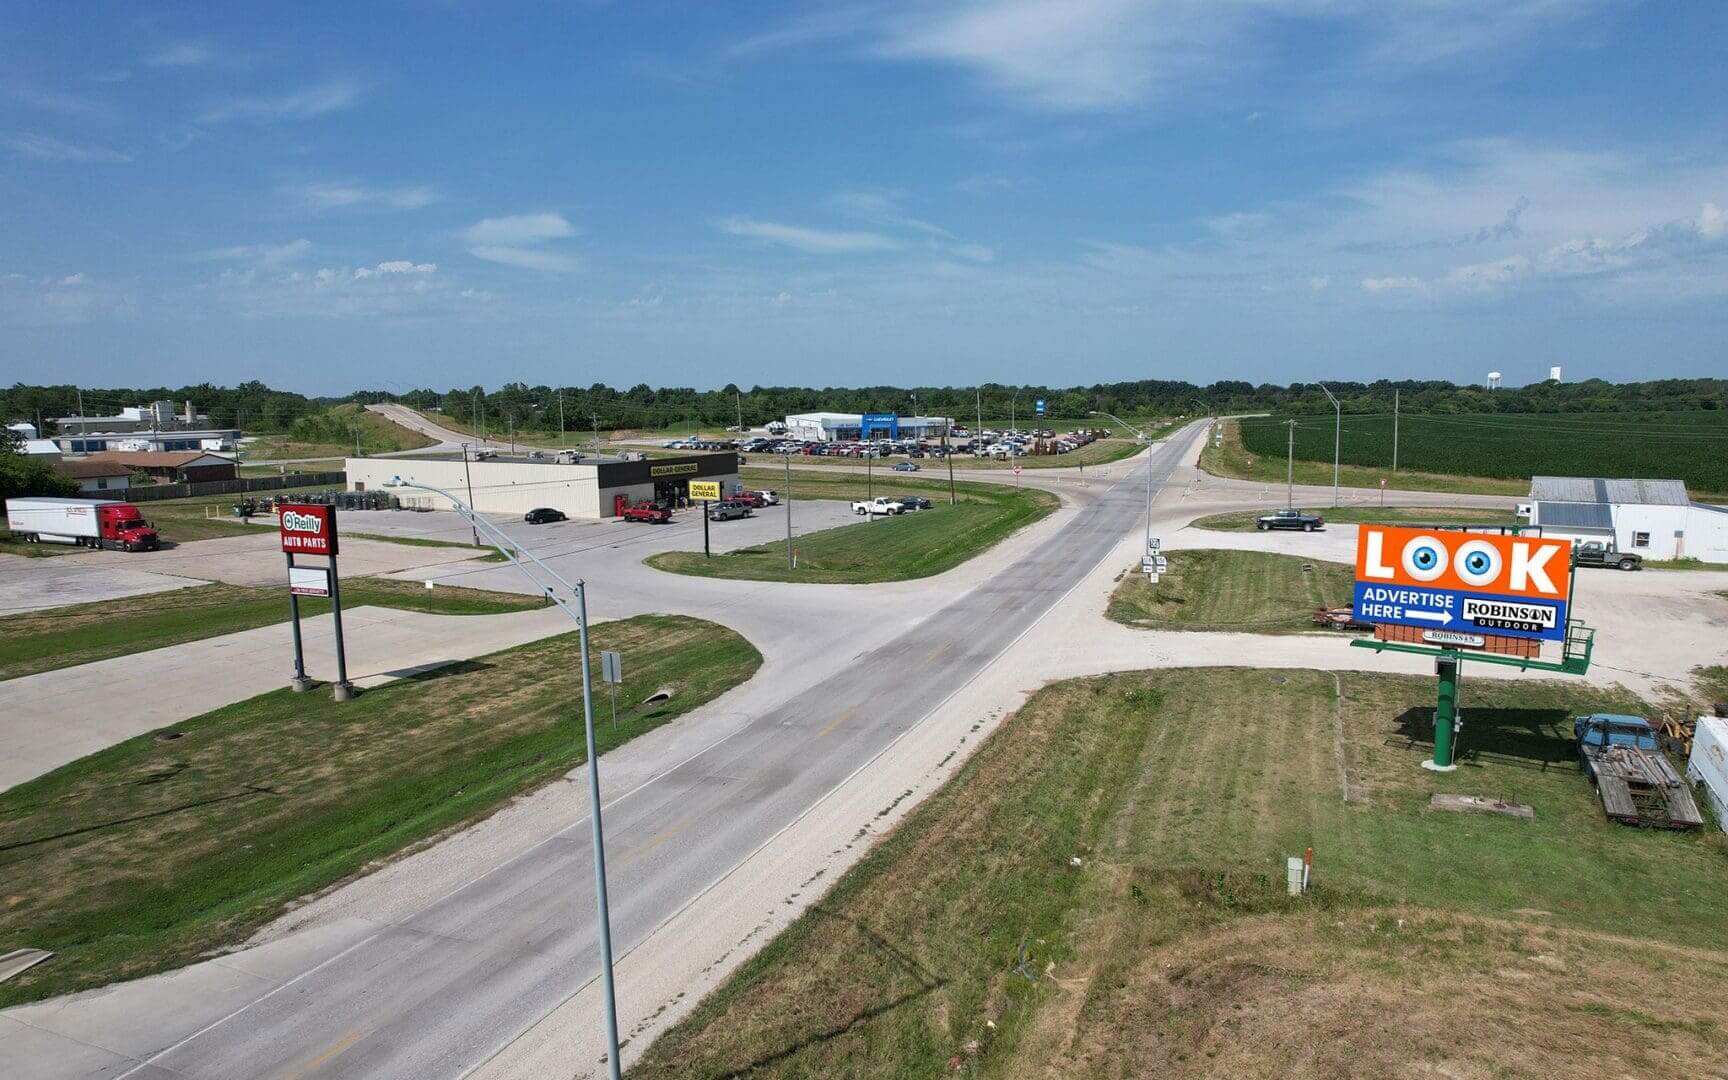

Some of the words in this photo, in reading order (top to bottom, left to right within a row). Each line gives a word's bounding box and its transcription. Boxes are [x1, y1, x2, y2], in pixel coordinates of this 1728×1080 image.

[653, 466, 673, 475] DOLLAR
[674, 464, 697, 473] GENERAL
[283, 511, 322, 534] O'Reilly
[283, 536, 302, 547] AUTO
[303, 537, 327, 548] PARTS
[1365, 531, 1562, 594] LOOK
[1362, 587, 1455, 608] ADVERTISE
[1361, 602, 1403, 619] HERE
[1467, 602, 1553, 622] ROBINSON
[1479, 618, 1538, 631] OUTDOOR
